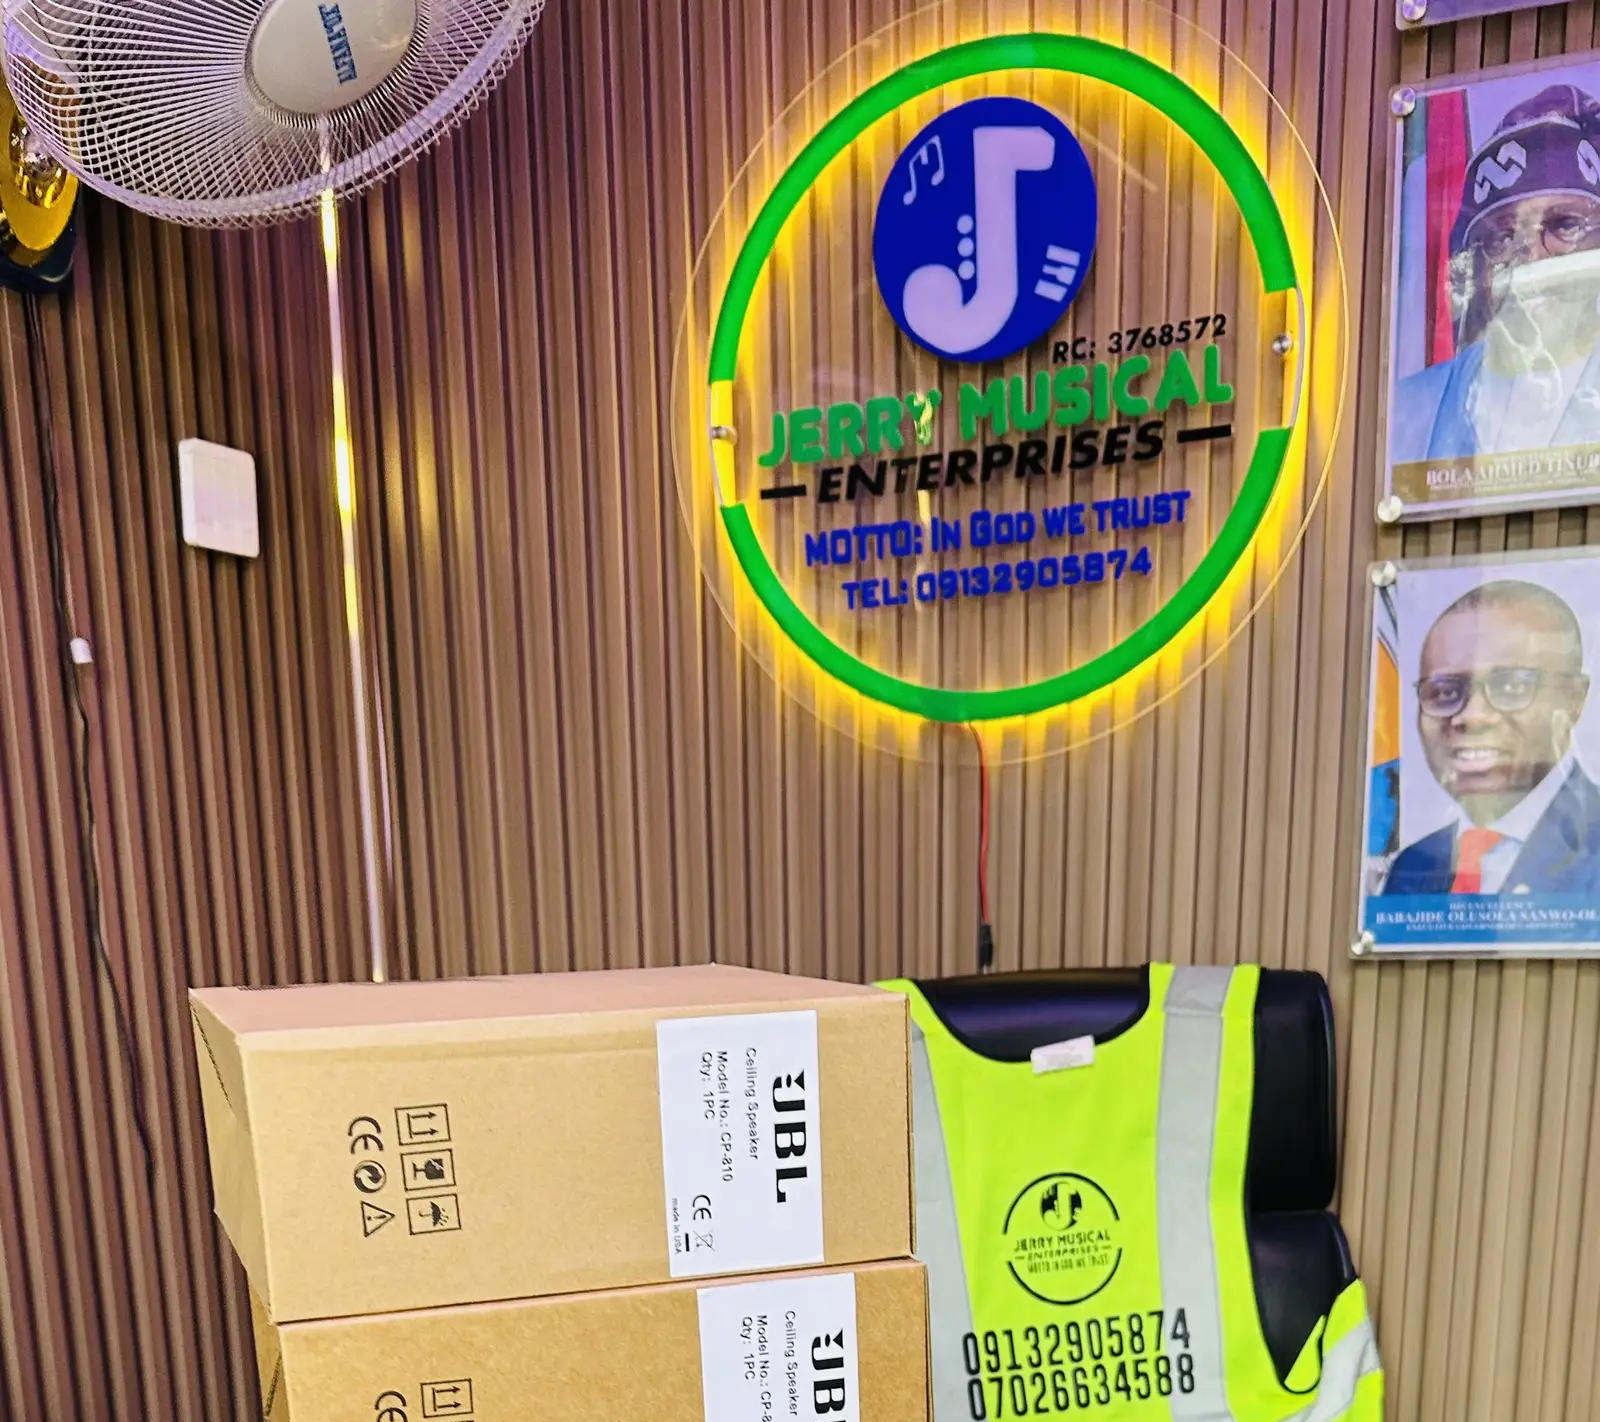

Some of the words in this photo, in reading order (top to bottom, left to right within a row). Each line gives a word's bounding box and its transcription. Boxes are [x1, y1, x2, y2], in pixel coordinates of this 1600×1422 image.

[1052, 336, 1096, 365] RC:
[1107, 313, 1228, 354] 3768572
[758, 389, 942, 467] JERRY
[959, 344, 1234, 441] MUSICAL
[816, 420, 1165, 503] ENTERPRISES
[804, 521, 922, 567] MOTTO:
[1043, 500, 1084, 538] WE
[1092, 490, 1191, 534] TRUST
[842, 578, 909, 610] TEL:
[916, 546, 1153, 603] 09132905874
[1518, 907, 1600, 923] SANWO-OL
[700, 1051, 713, 1082] Qty:
[716, 1051, 729, 1097] Model
[745, 1047, 757, 1097] Ceiling
[703, 1091, 715, 1120] 1PC
[718, 1099, 730, 1128] No.:
[745, 1101, 759, 1159] Speaker
[772, 1073, 808, 1203] JBL
[720, 1132, 733, 1182] CP-810
[672, 1198, 680, 1222] made
[673, 1224, 680, 1233] in
[674, 1235, 682, 1255] USA
[1014, 1236, 1053, 1252] JERRY
[1057, 1229, 1111, 1246] MUSICAL
[1028, 1245, 1099, 1261] ENTERPRISES
[740, 1316, 753, 1345] Qty:
[756, 1314, 769, 1357] Model
[784, 1309, 796, 1358] Ceiling
[962, 1307, 1190, 1376] 09132905874
[743, 1353, 755, 1380] 1PC
[759, 1359, 771, 1387] No.:
[784, 1361, 798, 1416] Speaker
[967, 1353, 1195, 1421] 07026634588
